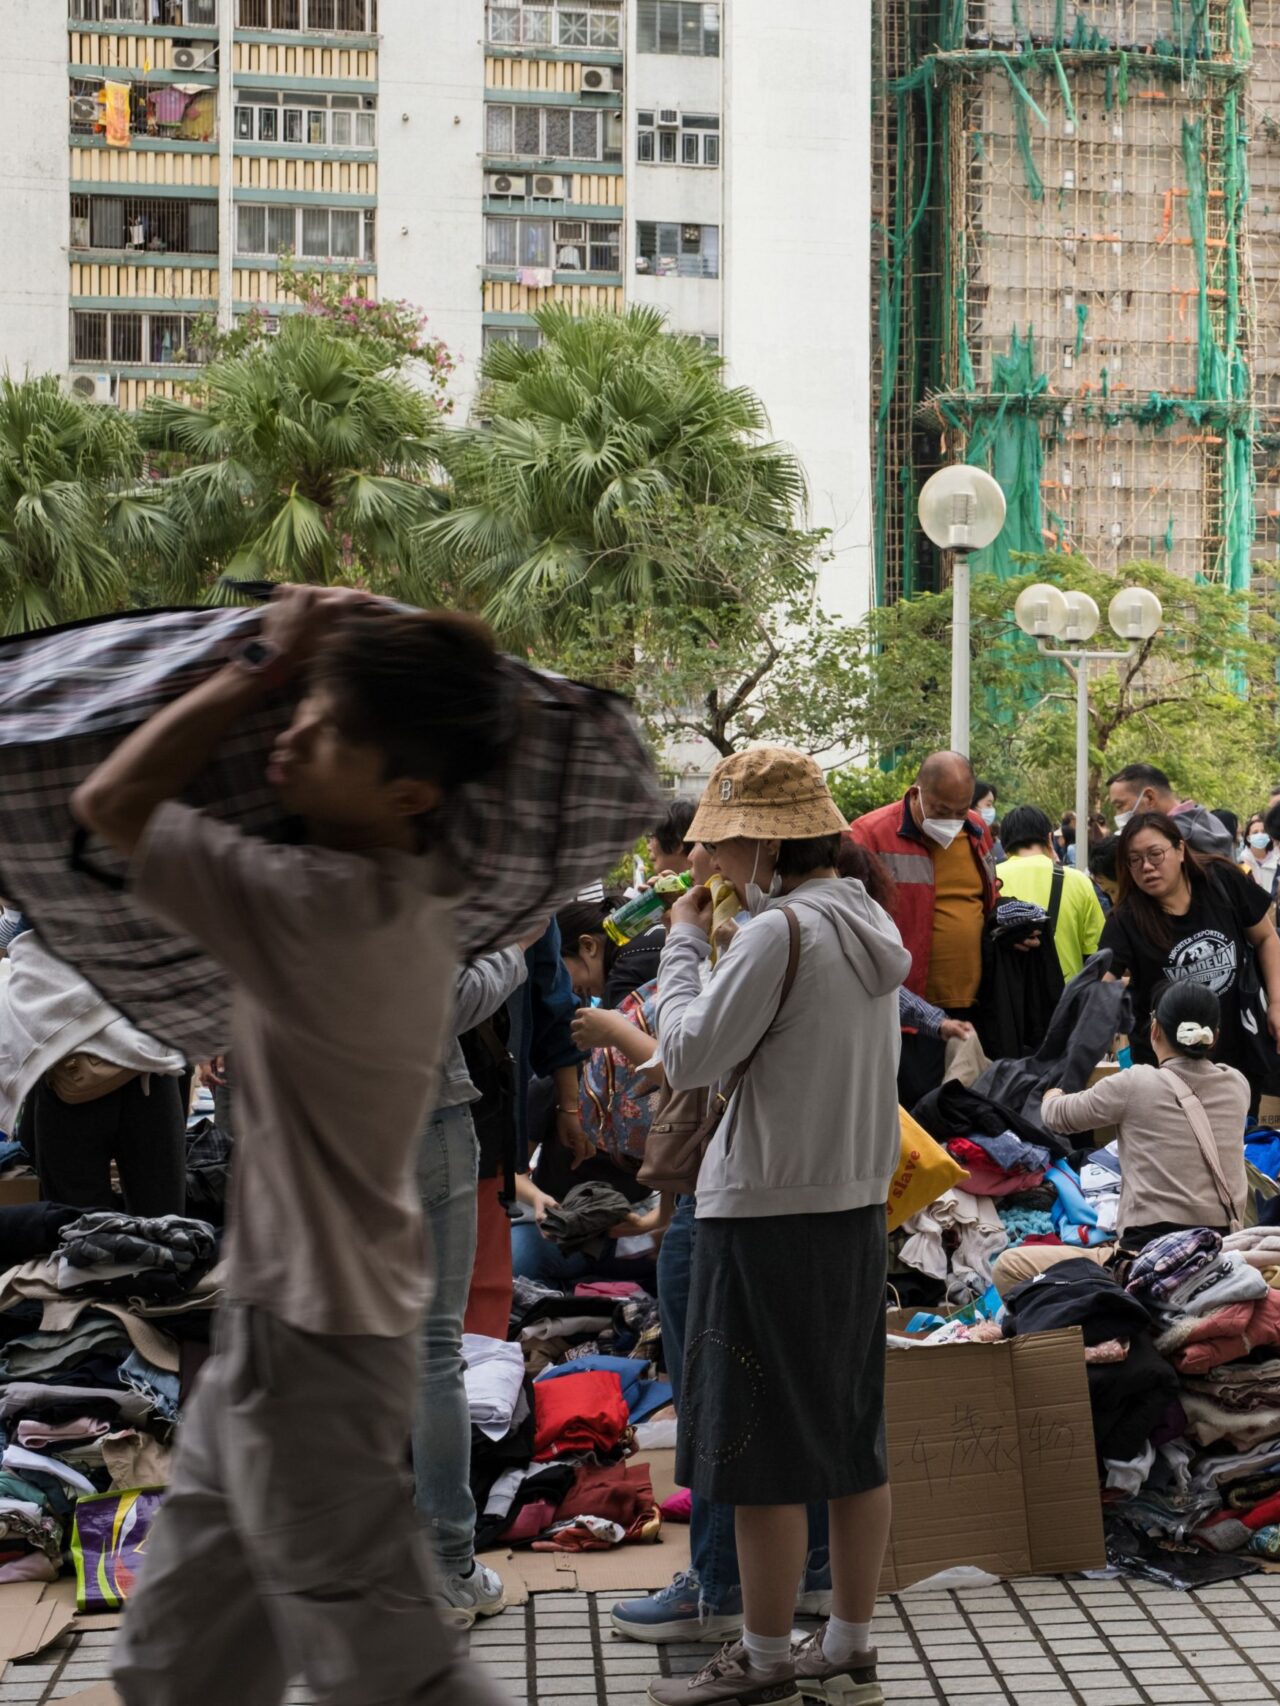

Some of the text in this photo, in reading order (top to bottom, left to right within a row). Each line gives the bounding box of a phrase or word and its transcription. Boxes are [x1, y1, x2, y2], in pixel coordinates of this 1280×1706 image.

[720, 778, 732, 801] B
[1193, 929, 1225, 940] EXPORTER
[1164, 943, 1236, 983] VANDELAY
[892, 1150, 921, 1199] slave
